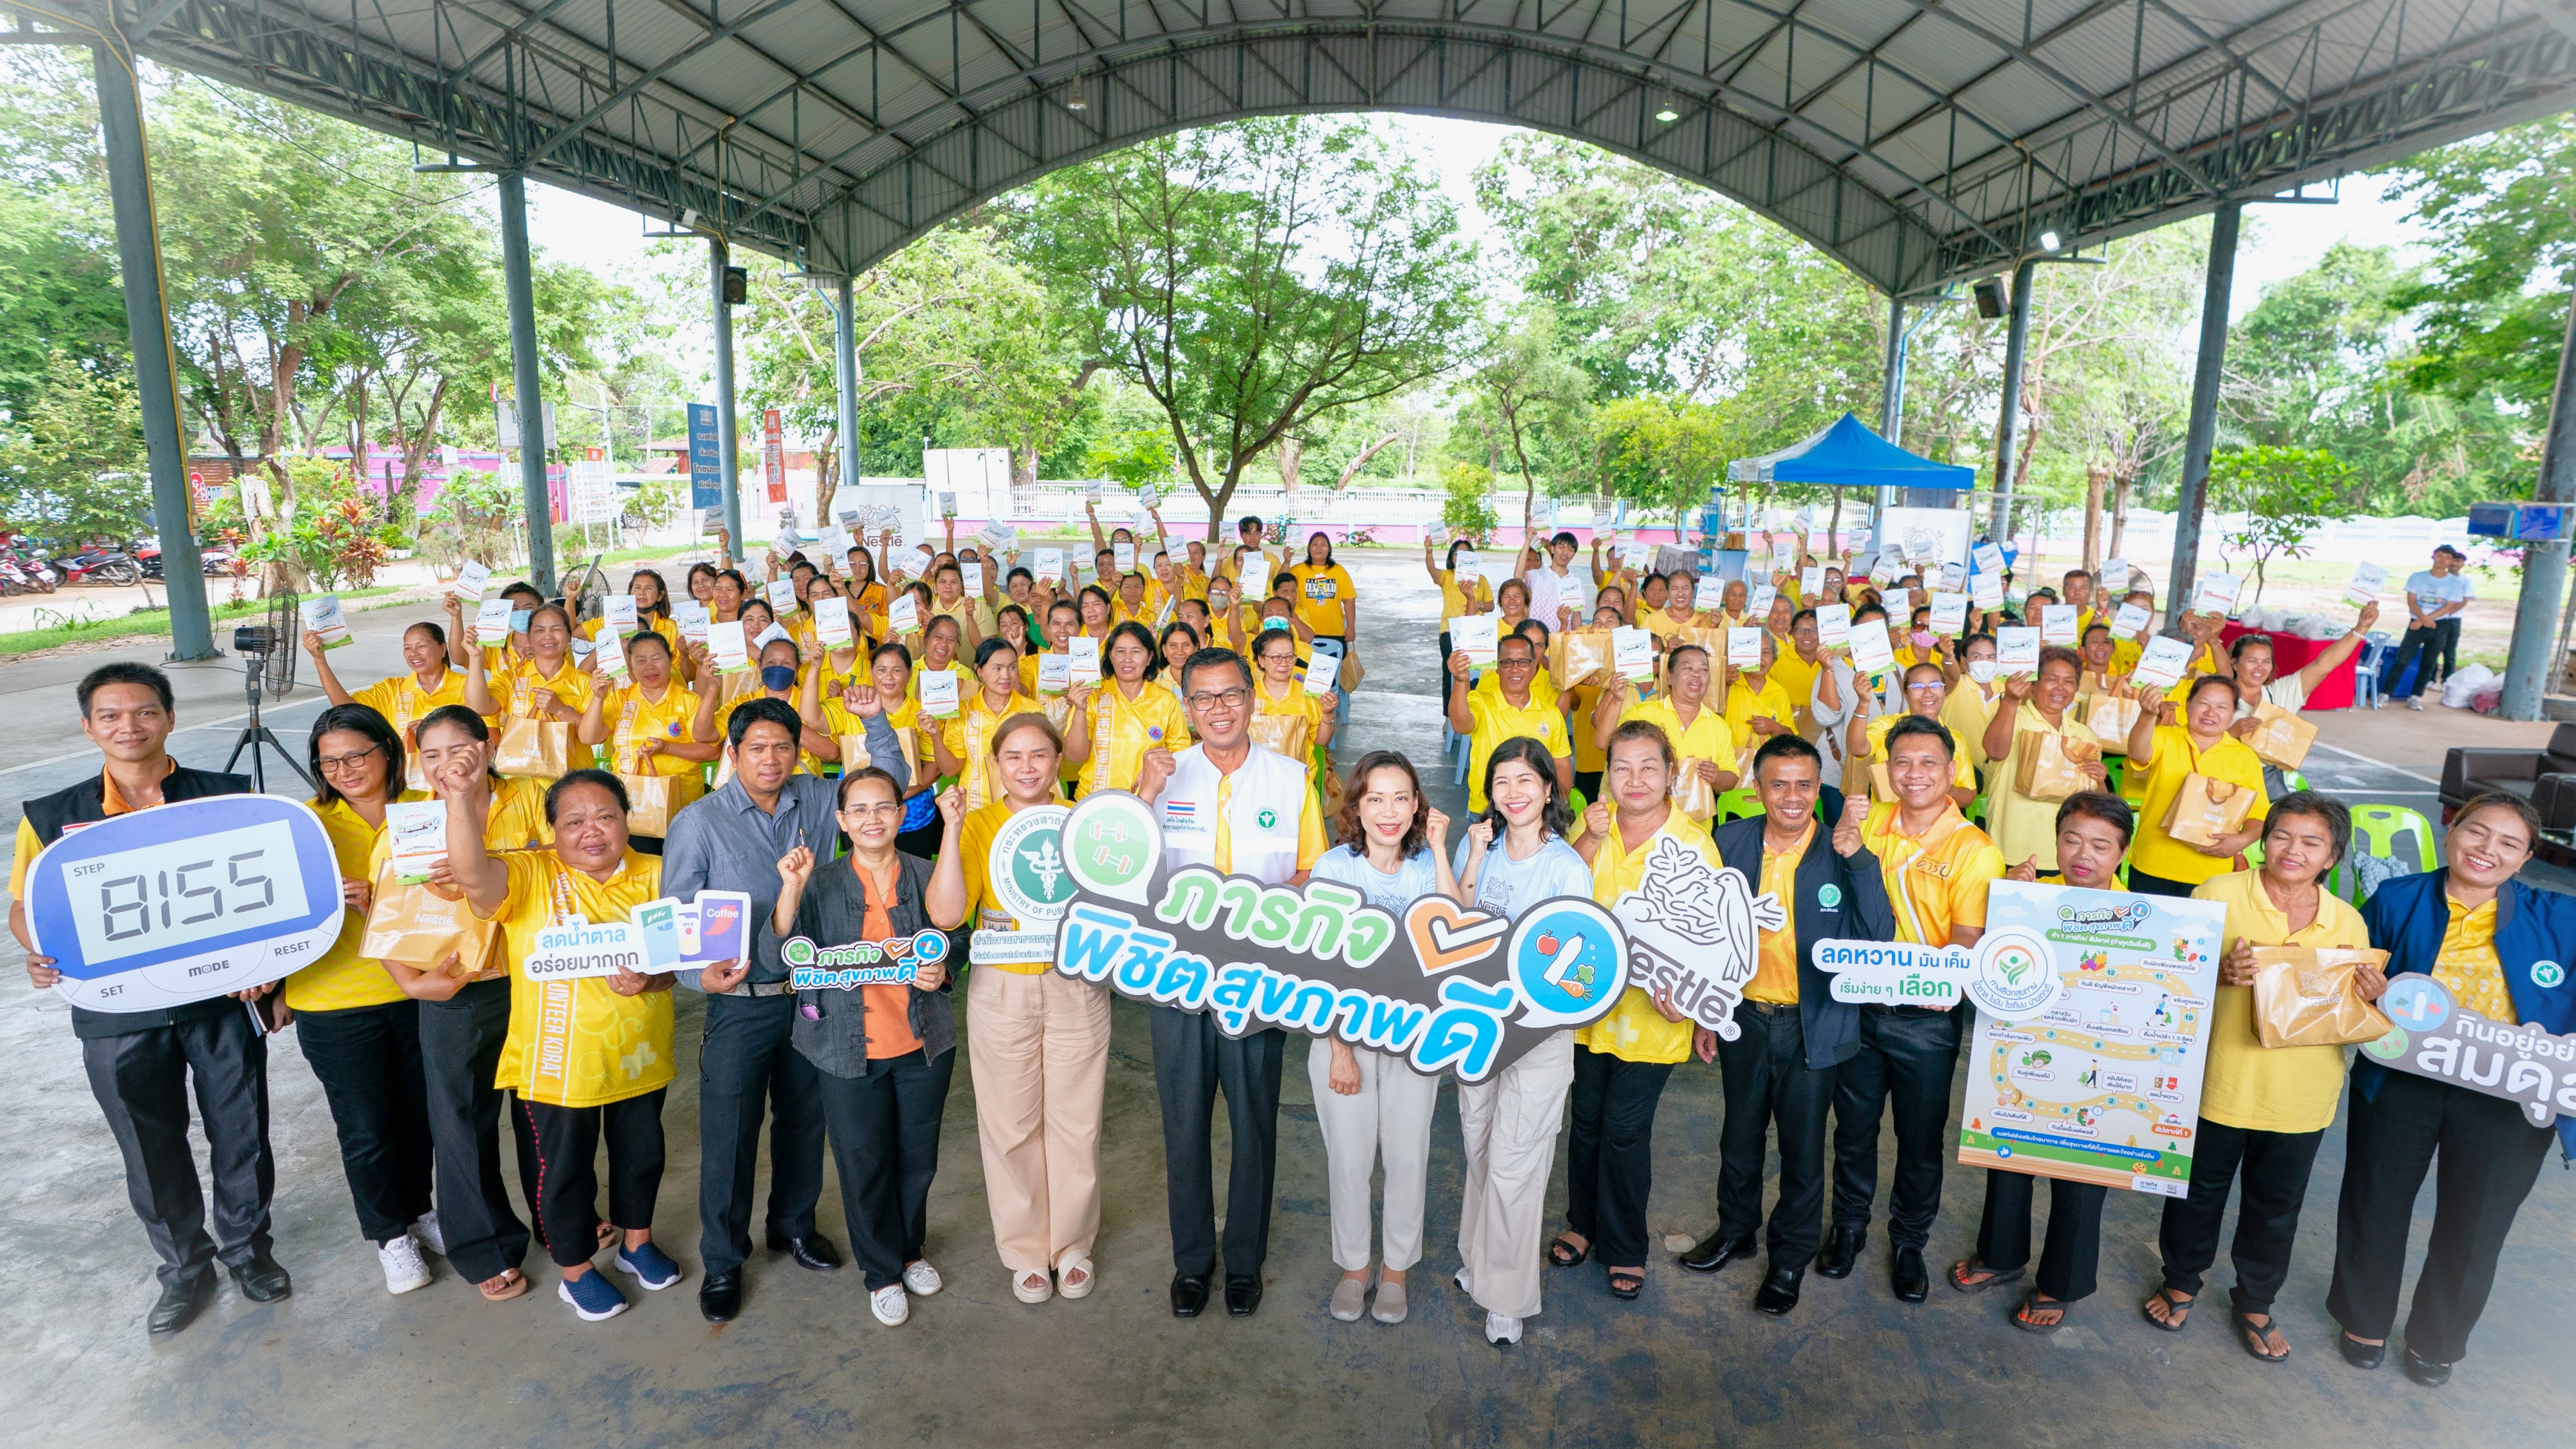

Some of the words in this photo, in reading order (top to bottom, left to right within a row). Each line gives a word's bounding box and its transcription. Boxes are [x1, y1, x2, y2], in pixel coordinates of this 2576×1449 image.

[1003, 815, 1065, 854] กระทรวงสาธ
[73, 863, 105, 877] STEP
[100, 849, 274, 941] 8155
[1003, 877, 1031, 910] MINISTRY
[1033, 906, 1043, 915] OF
[414, 913, 454, 926] Nestlé
[707, 908, 739, 918] Coffee
[1162, 875, 1388, 962] ภารกิจ
[2077, 910, 2113, 921] ภารกิจ
[542, 921, 626, 949] ลดน้ำตาล
[274, 941, 311, 957] RESET
[818, 946, 882, 965] ภารกิจ
[1821, 947, 1912, 967] ลดหวาน
[1919, 953, 1939, 968] มัน
[1945, 951, 1970, 969] เค็ม
[532, 951, 639, 974] อร่อยมากกก
[100, 984, 125, 999] SET
[1625, 935, 1736, 1025] estlé
[1840, 977, 1881, 995] เริ่มง่าย
[1886, 986, 1894, 998] ๆ
[1899, 973, 1952, 997] เลือก
[543, 979, 569, 1034] UNTEER
[2455, 1014, 2576, 1062] กินอยู่อย่
[540, 1036, 565, 1080] KORAT
